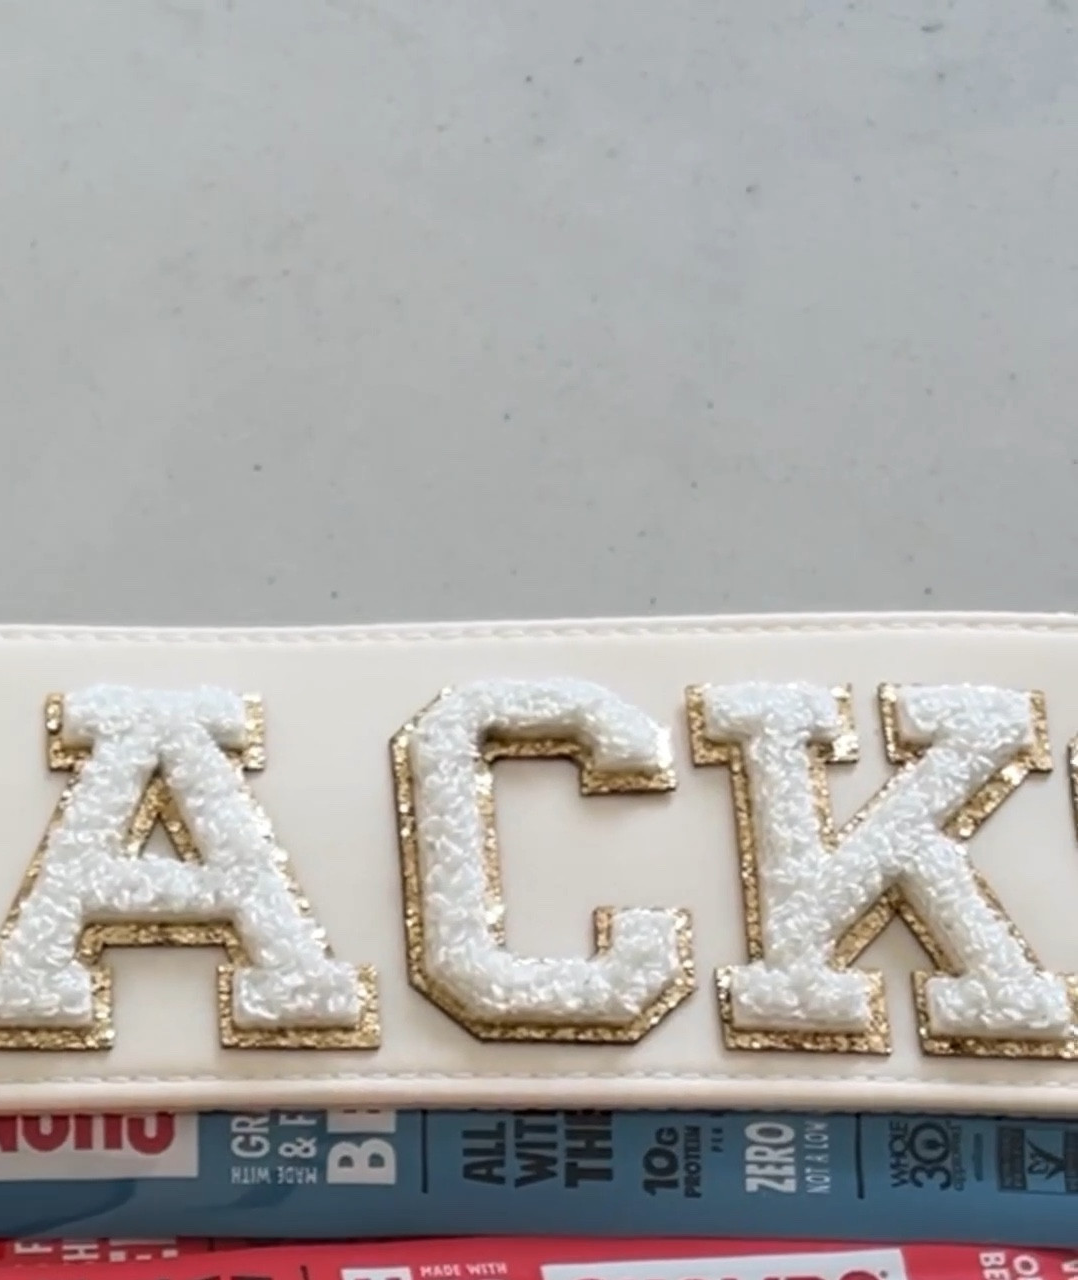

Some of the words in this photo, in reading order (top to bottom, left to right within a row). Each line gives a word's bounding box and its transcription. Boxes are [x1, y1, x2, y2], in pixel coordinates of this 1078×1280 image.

[230, 1166, 272, 1185] WITH
[276, 1166, 318, 1185] MADE
[462, 1121, 507, 1186] ALL
[514, 1111, 559, 1189] WIT
[684, 1125, 702, 1198] PROTEIN
[745, 1121, 797, 1193] ZERO
[420, 1264, 461, 1278] MADE
[465, 1262, 508, 1275] WITH
